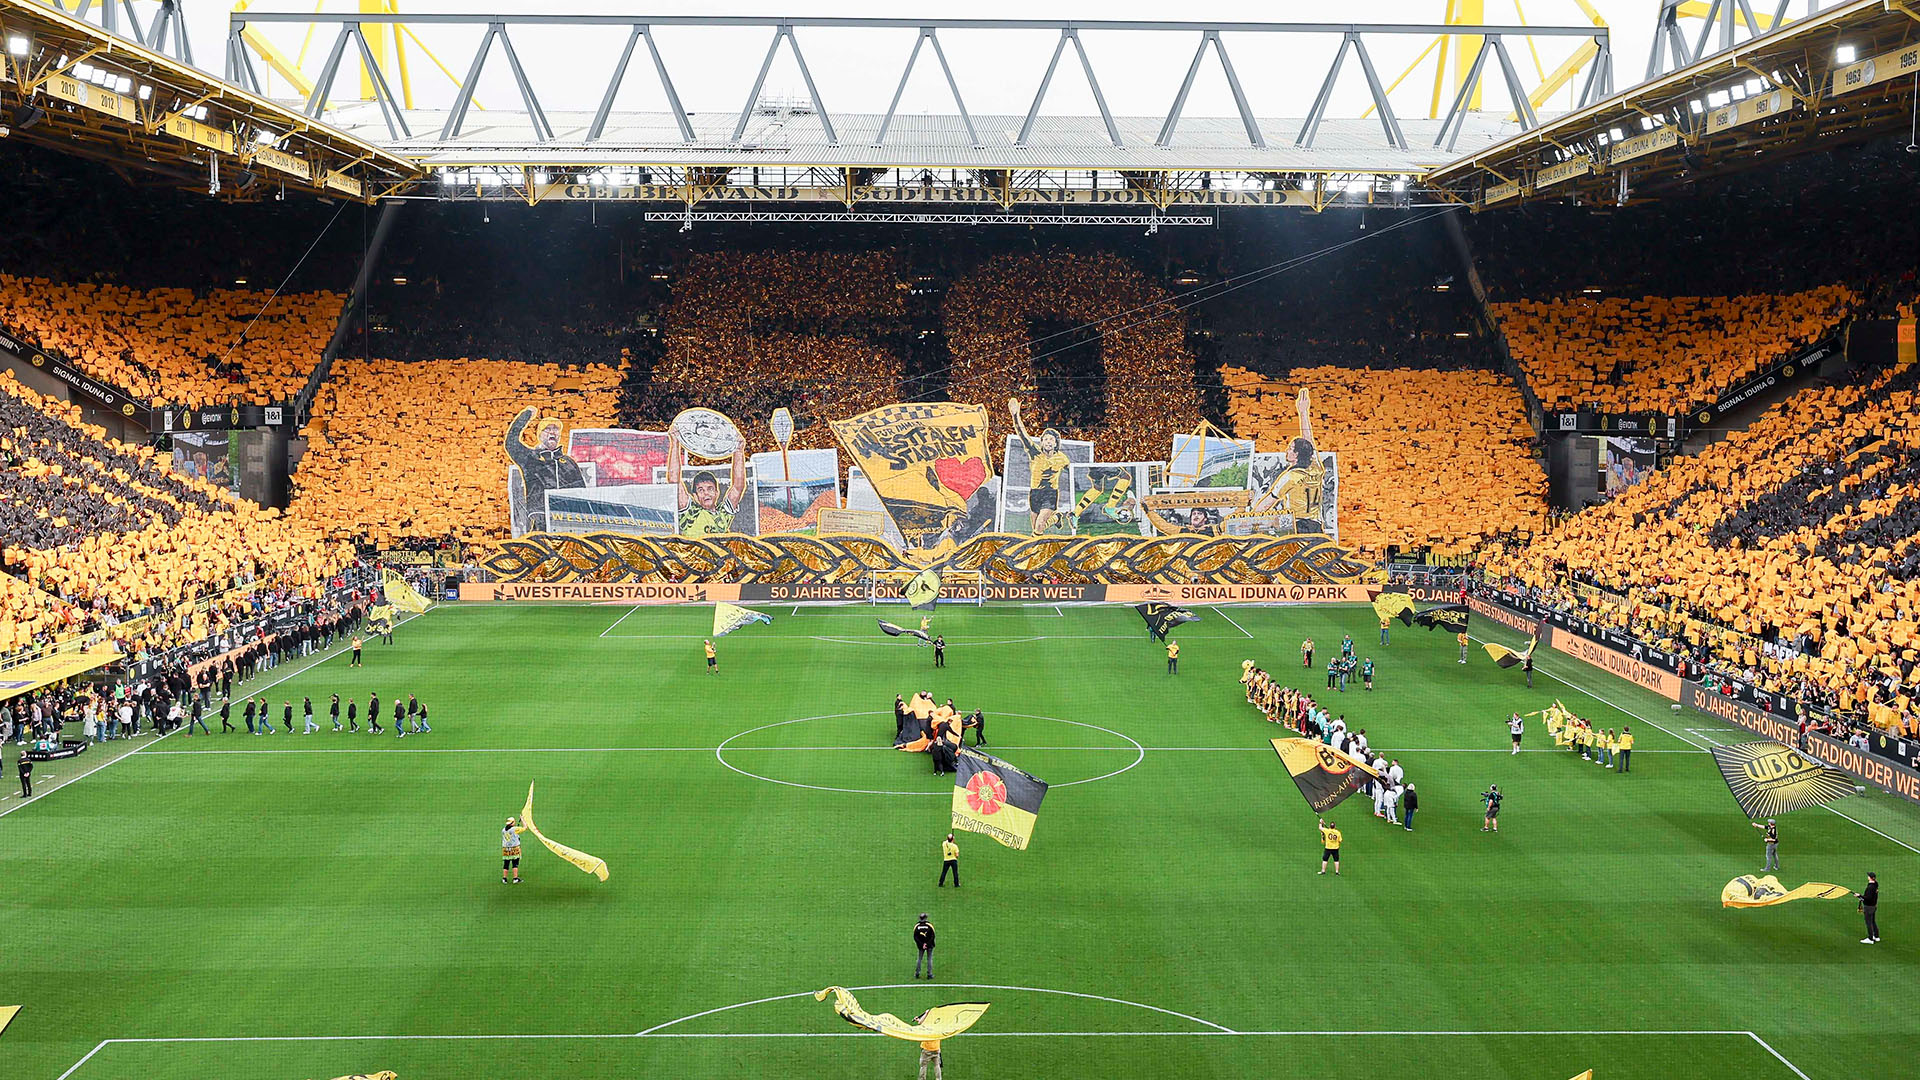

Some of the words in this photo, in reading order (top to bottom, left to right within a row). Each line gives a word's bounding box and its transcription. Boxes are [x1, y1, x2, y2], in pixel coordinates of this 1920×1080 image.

[1899, 50, 1918, 68] 1965
[1845, 69, 1861, 86] 1963
[61, 81, 76, 97] 2012
[101, 95, 115, 110] 2012
[176, 120, 187, 134] 2017
[206, 131, 217, 144] 2021
[1613, 144, 1632, 160] SIGNAL
[1632, 138, 1650, 153] IDUNA
[1660, 130, 1676, 144] PARK
[564, 185, 679, 199] GELBE
[700, 187, 800, 200] WAND
[852, 186, 1076, 201] SÜDTRIBÜNE
[1089, 189, 1289, 205] DORTMUND
[53, 366, 81, 386] SIGNAL
[80, 382, 105, 401] IDUNA
[1717, 393, 1745, 413] SIGNAL
[1744, 381, 1768, 401] IDUNA
[266, 411, 280, 420] 1&1
[1561, 417, 1575, 427] 1&1
[852, 424, 977, 459] WESTFALEN
[884, 443, 968, 470] STADION
[551, 511, 674, 530] WESTFALENSTADION
[514, 586, 687, 599] WESTFALENSTADION
[770, 587, 789, 599] 50
[791, 587, 841, 599] JAHRE
[1009, 587, 1039, 599] DER
[1043, 587, 1085, 599] WELT
[1181, 587, 1236, 599] SIGNAL
[1240, 587, 1285, 599] IDUNA
[1307, 587, 1347, 599] PARK
[1408, 588, 1425, 600] 50
[1428, 590, 1462, 604] JAHR
[1491, 606, 1514, 628] STADION
[1513, 615, 1526, 632] DER
[1582, 643, 1607, 666] SIGNAL
[1609, 653, 1630, 676] IDUNA
[1640, 667, 1662, 690] PARK
[1694, 689, 1706, 707] 50
[1706, 697, 1738, 723] JAHRE
[1807, 738, 1863, 775] STADION
[1865, 757, 1893, 788] DER
[1895, 770, 1920, 800] WE
[1314, 773, 1354, 809] RHEIN-AHR
